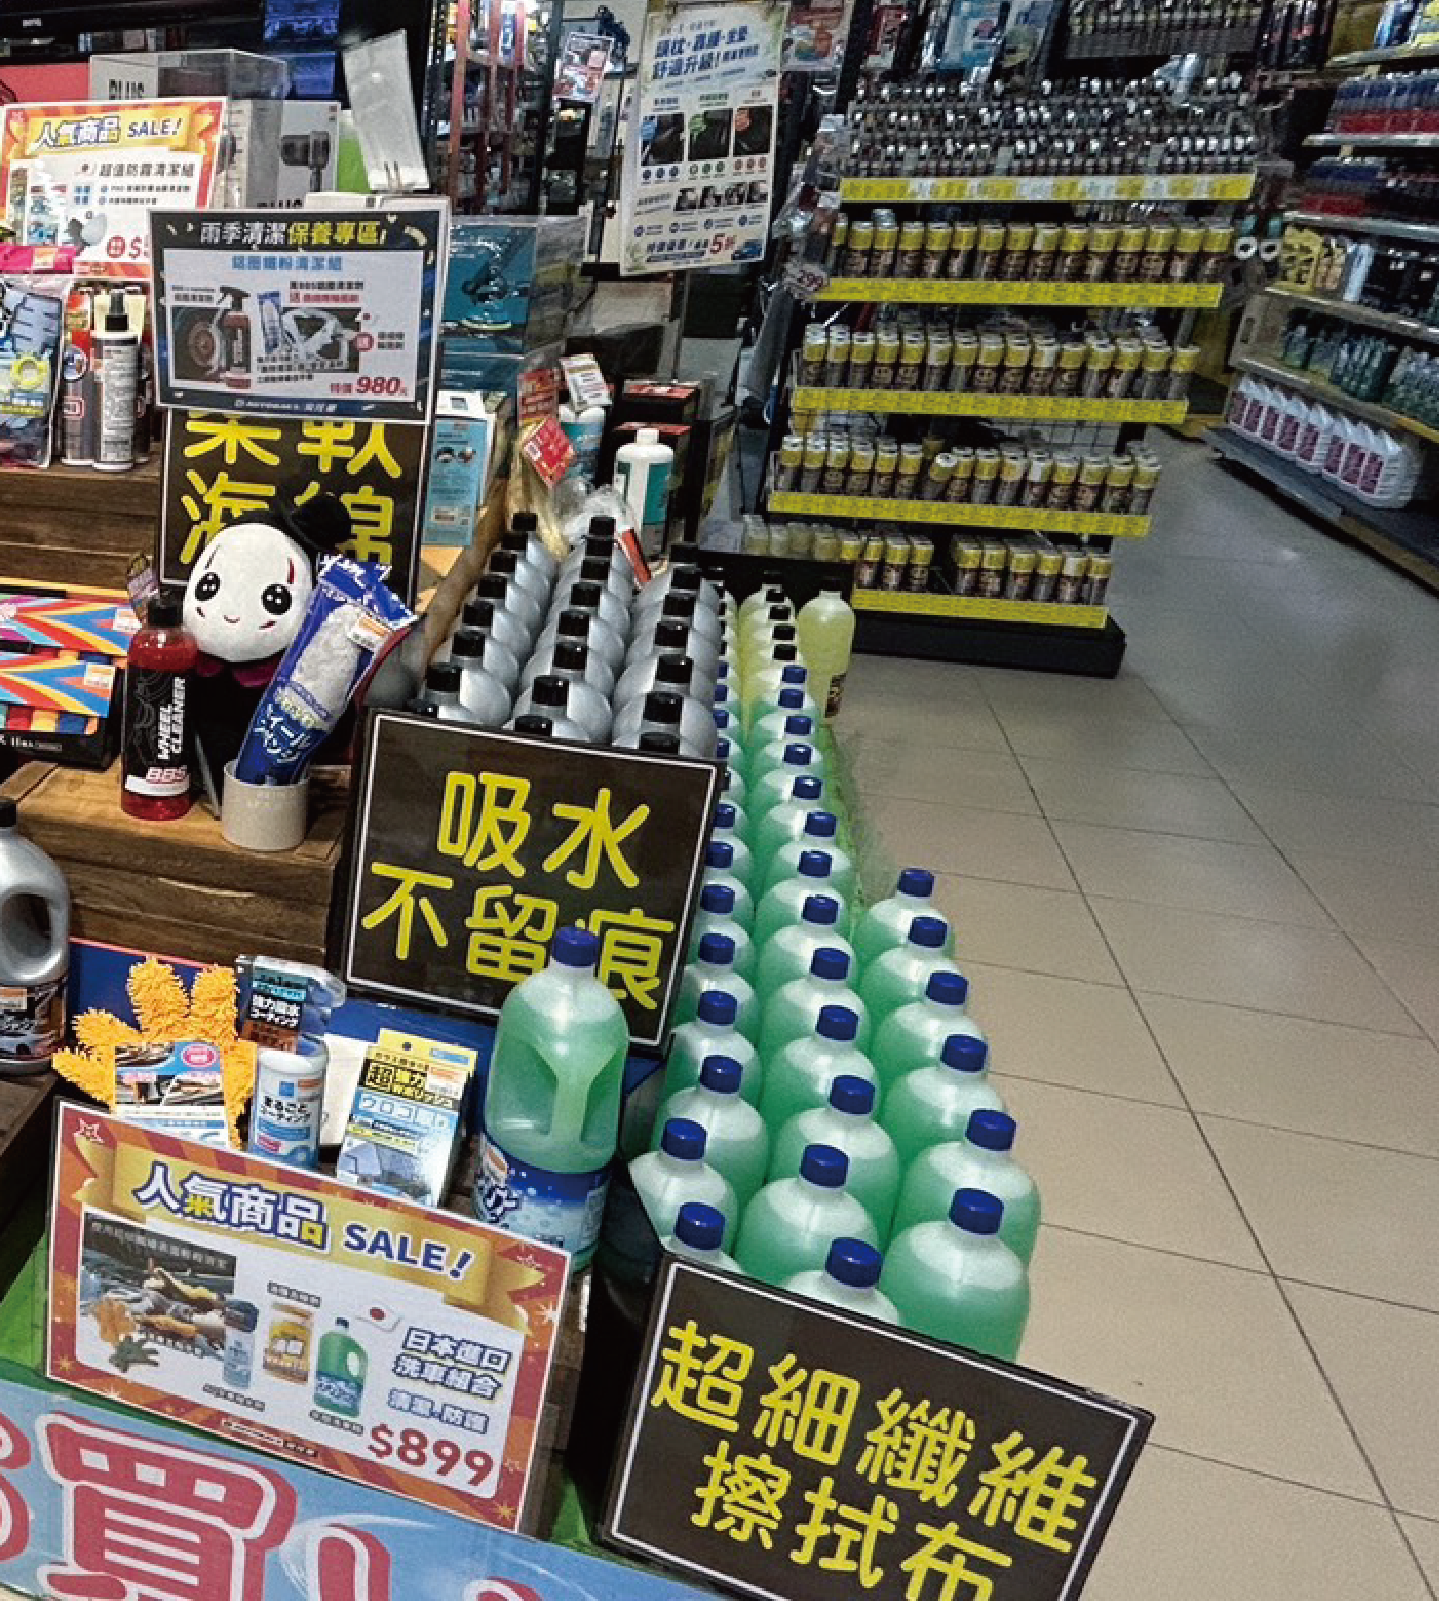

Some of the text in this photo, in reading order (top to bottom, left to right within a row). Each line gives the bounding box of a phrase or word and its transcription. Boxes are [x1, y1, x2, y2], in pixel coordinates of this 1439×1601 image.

[127, 118, 182, 138] SALE!
[356, 376, 400, 395] 980
[156, 704, 173, 761] WHEEL
[170, 676, 187, 755] CLEANER
[145, 765, 189, 785] BBS
[436, 770, 651, 890] 吸水
[361, 861, 676, 1010] 不留痕
[132, 1161, 330, 1253] 人氣商品
[342, 1222, 473, 1280] SALE!
[392, 1353, 502, 1402] 洗車組合
[402, 1325, 512, 1374] 日本進口
[367, 1423, 494, 1487] $899
[651, 1320, 1097, 1554] 超細纖維
[690, 1441, 1014, 1600] 擦拭布
